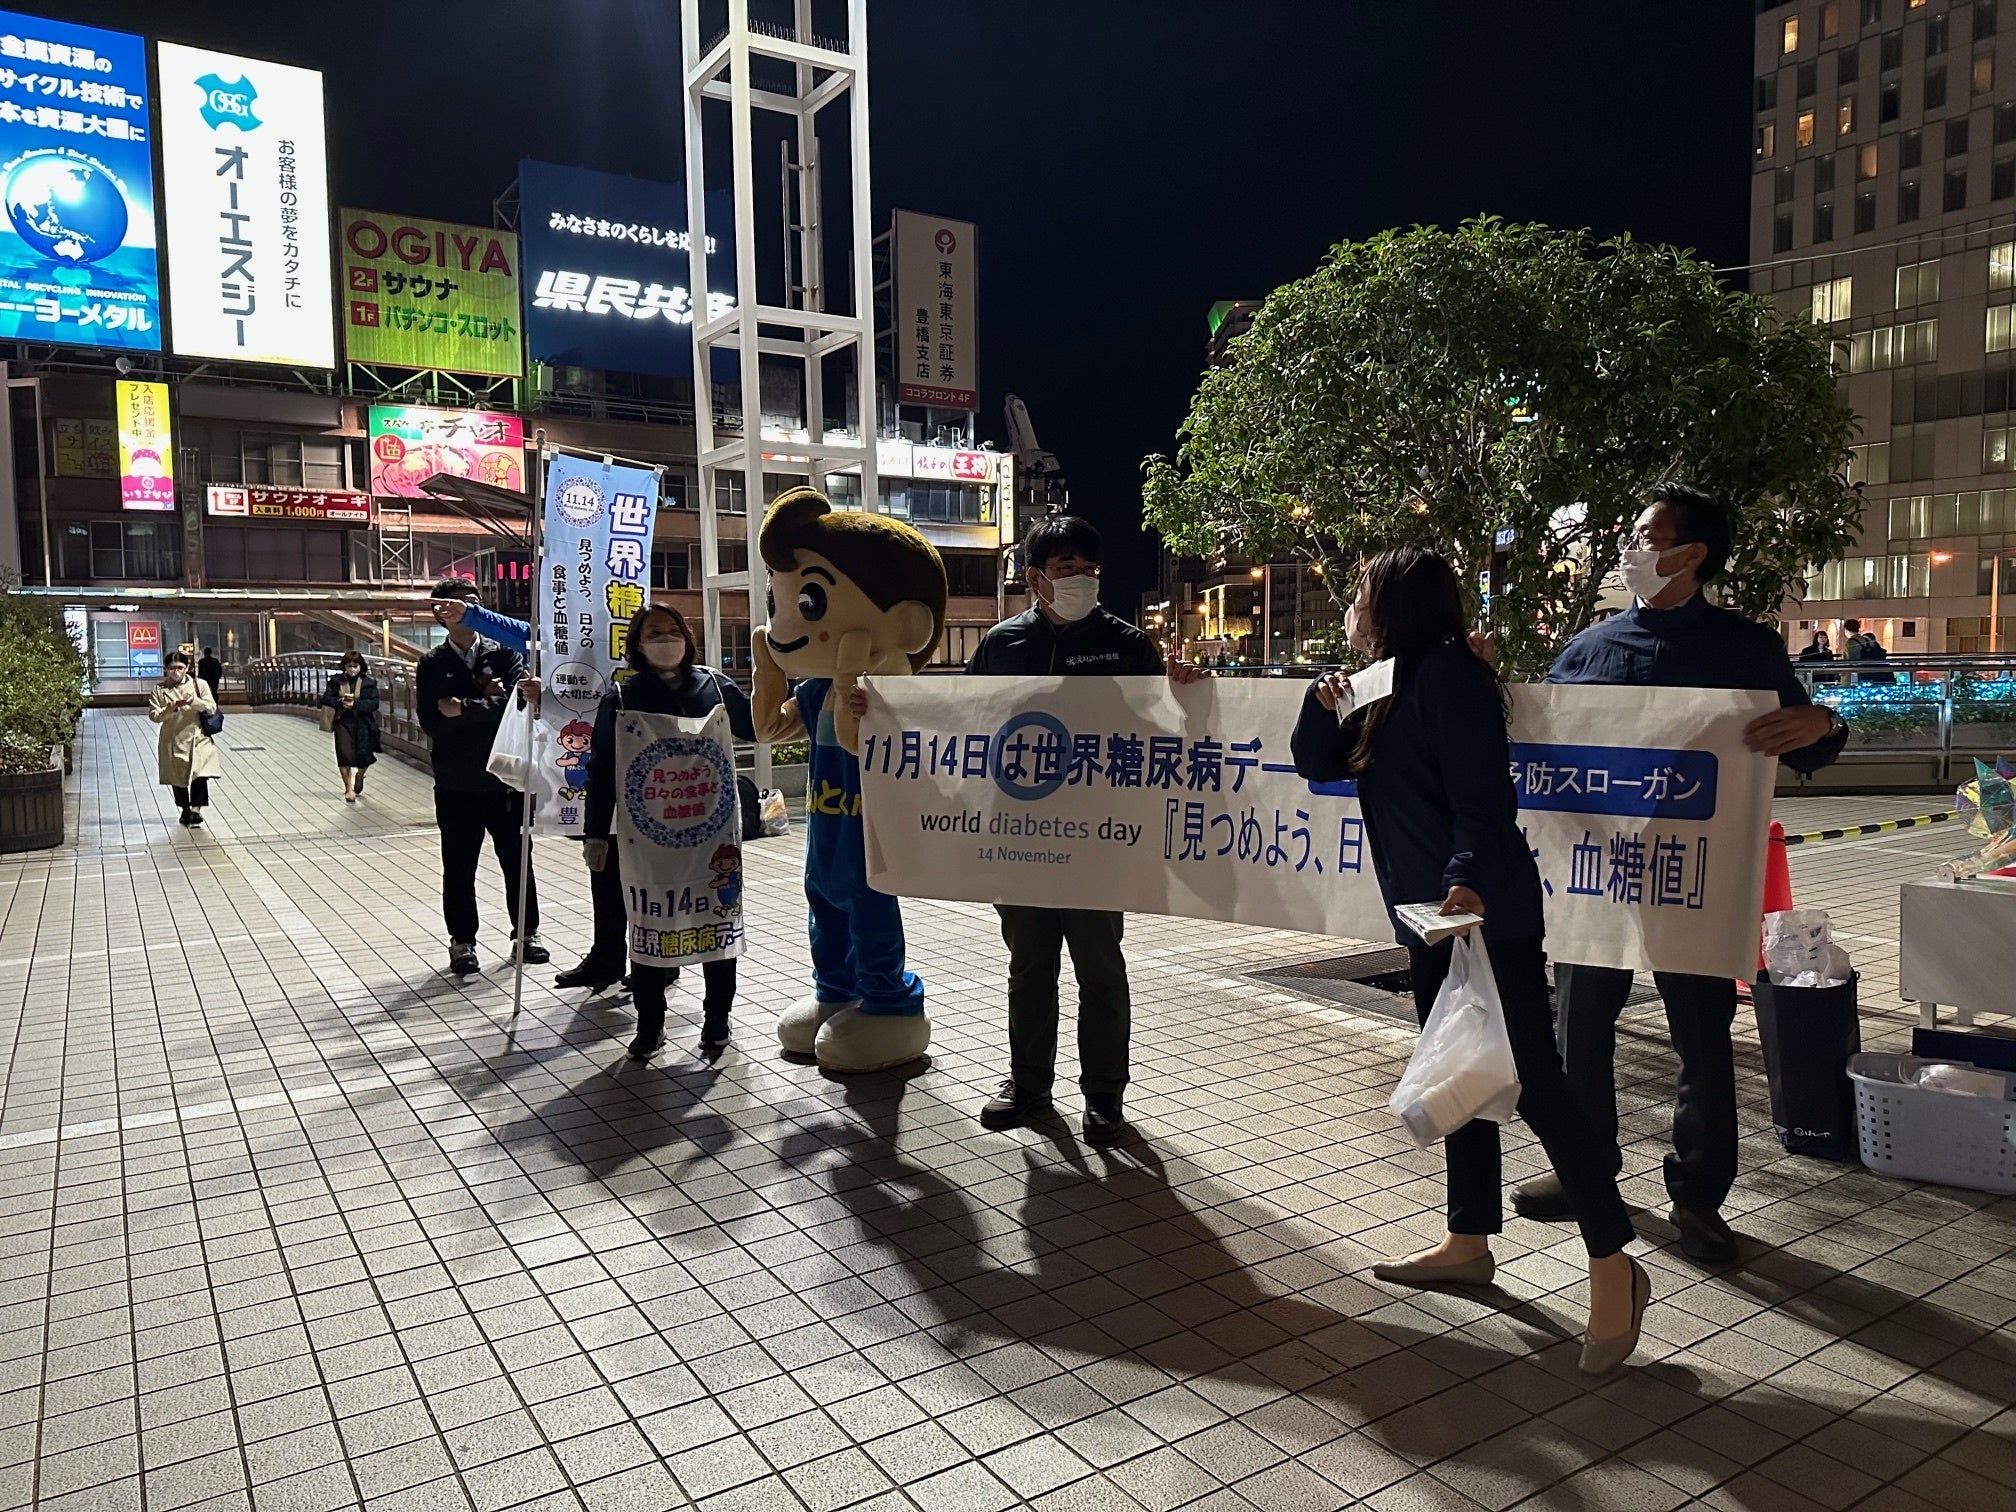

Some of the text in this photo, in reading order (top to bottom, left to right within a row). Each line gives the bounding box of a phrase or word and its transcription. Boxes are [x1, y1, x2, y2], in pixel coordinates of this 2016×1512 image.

[278, 139, 302, 309] お客様の夢をカタチに
[215, 145, 256, 346] オーエスジー
[347, 220, 513, 277] OGIYA
[85, 288, 147, 303] INNOVATION
[353, 271, 458, 300] 2F サウナ
[356, 305, 516, 342] 1F パチンコ・スロット
[938, 260, 955, 382] 東海東京証券
[915, 307, 930, 379] 豊橋支店
[906, 388, 970, 403] ココラフロント 4F
[252, 490, 367, 508] サウナオーギ
[285, 506, 324, 518] 1,000円
[566, 493, 594, 507] 11.14
[552, 564, 569, 656] 食事と血糖値
[556, 674, 588, 686] 運動も
[559, 689, 602, 700] 大切だよ
[652, 765, 712, 783] 見つめよう
[864, 731, 1298, 793] 11月14日は世界糖尿病デー
[643, 781, 720, 801] 日々の食事と
[663, 803, 706, 820] 血糖値
[920, 810, 1142, 847] world diabetes day
[977, 846, 1072, 865] 14 November
[629, 886, 710, 918] 11月14日
[632, 921, 743, 957] 世界糖尿病デー
